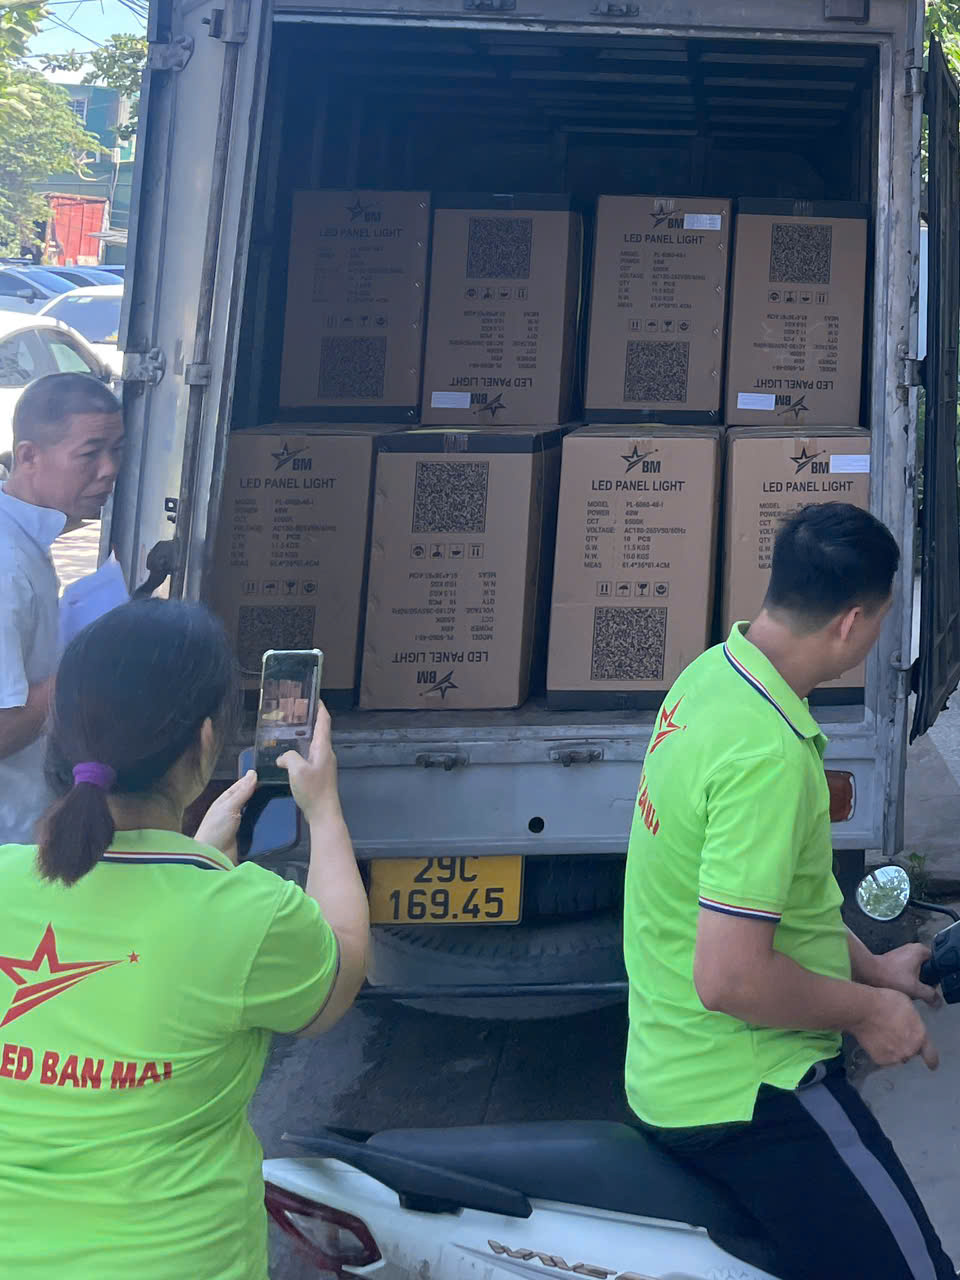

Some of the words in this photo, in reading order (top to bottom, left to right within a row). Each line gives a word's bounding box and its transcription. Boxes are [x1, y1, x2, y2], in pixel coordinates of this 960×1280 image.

[320, 228, 338, 238] LED
[340, 228, 371, 238] PANEL
[373, 228, 403, 238] LIGHT
[624, 234, 642, 242] LED
[645, 234, 674, 243] PANEL
[677, 235, 704, 244] LIGHT
[449, 377, 478, 386] LIGHT
[481, 377, 511, 386] PANEL
[514, 378, 532, 387] LED
[753, 379, 782, 388] LIGHT
[784, 380, 813, 389] PANEL
[817, 381, 833, 389] LED
[292, 458, 312, 471] BM
[642, 460, 661, 473] BM
[811, 462, 829, 474] BM
[240, 479, 261, 488] LED
[265, 479, 300, 488] PANEL
[304, 479, 336, 488] LIGHT
[592, 480, 612, 491] LED
[616, 480, 649, 491] PANEL
[653, 481, 685, 491] LIGHT
[763, 482, 782, 492] LED
[786, 481, 819, 492] PANEL
[822, 481, 854, 491] LIGHT
[392, 652, 426, 663] LIGHT
[429, 652, 464, 663] PANEL
[468, 651, 488, 662] LED
[417, 671, 437, 684] BM
[413, 856, 478, 883] 29C
[389, 888, 504, 920] 169.45
[40, 1050, 104, 1089] BAN
